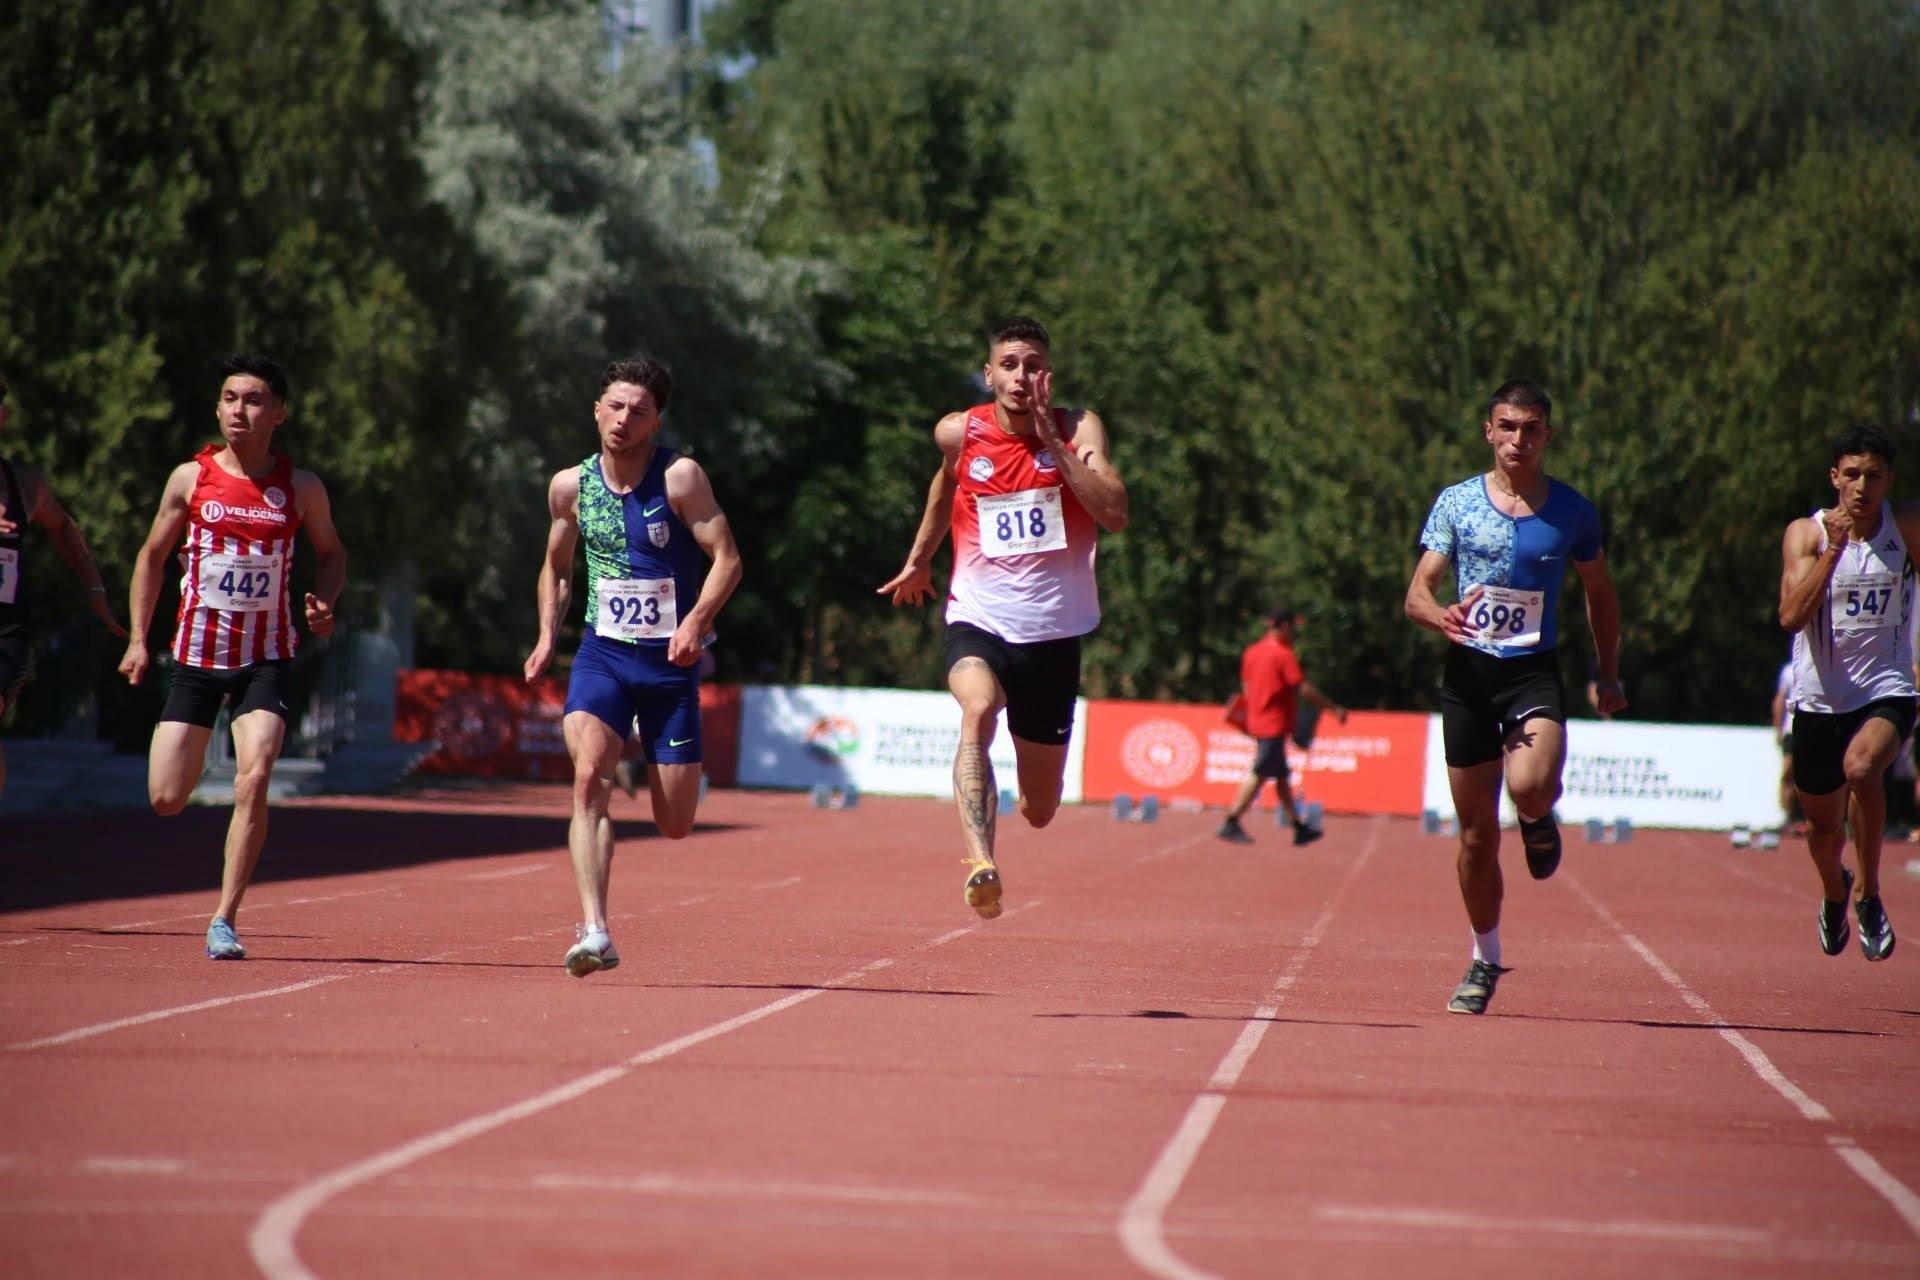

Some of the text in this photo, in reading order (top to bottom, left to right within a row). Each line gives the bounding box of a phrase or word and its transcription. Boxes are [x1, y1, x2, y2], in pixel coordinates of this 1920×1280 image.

[996, 507, 1046, 541] 818
[218, 571, 271, 598] 442
[609, 596, 661, 625] 923
[1846, 589, 1892, 616] 547
[1475, 602, 1526, 633] 698
